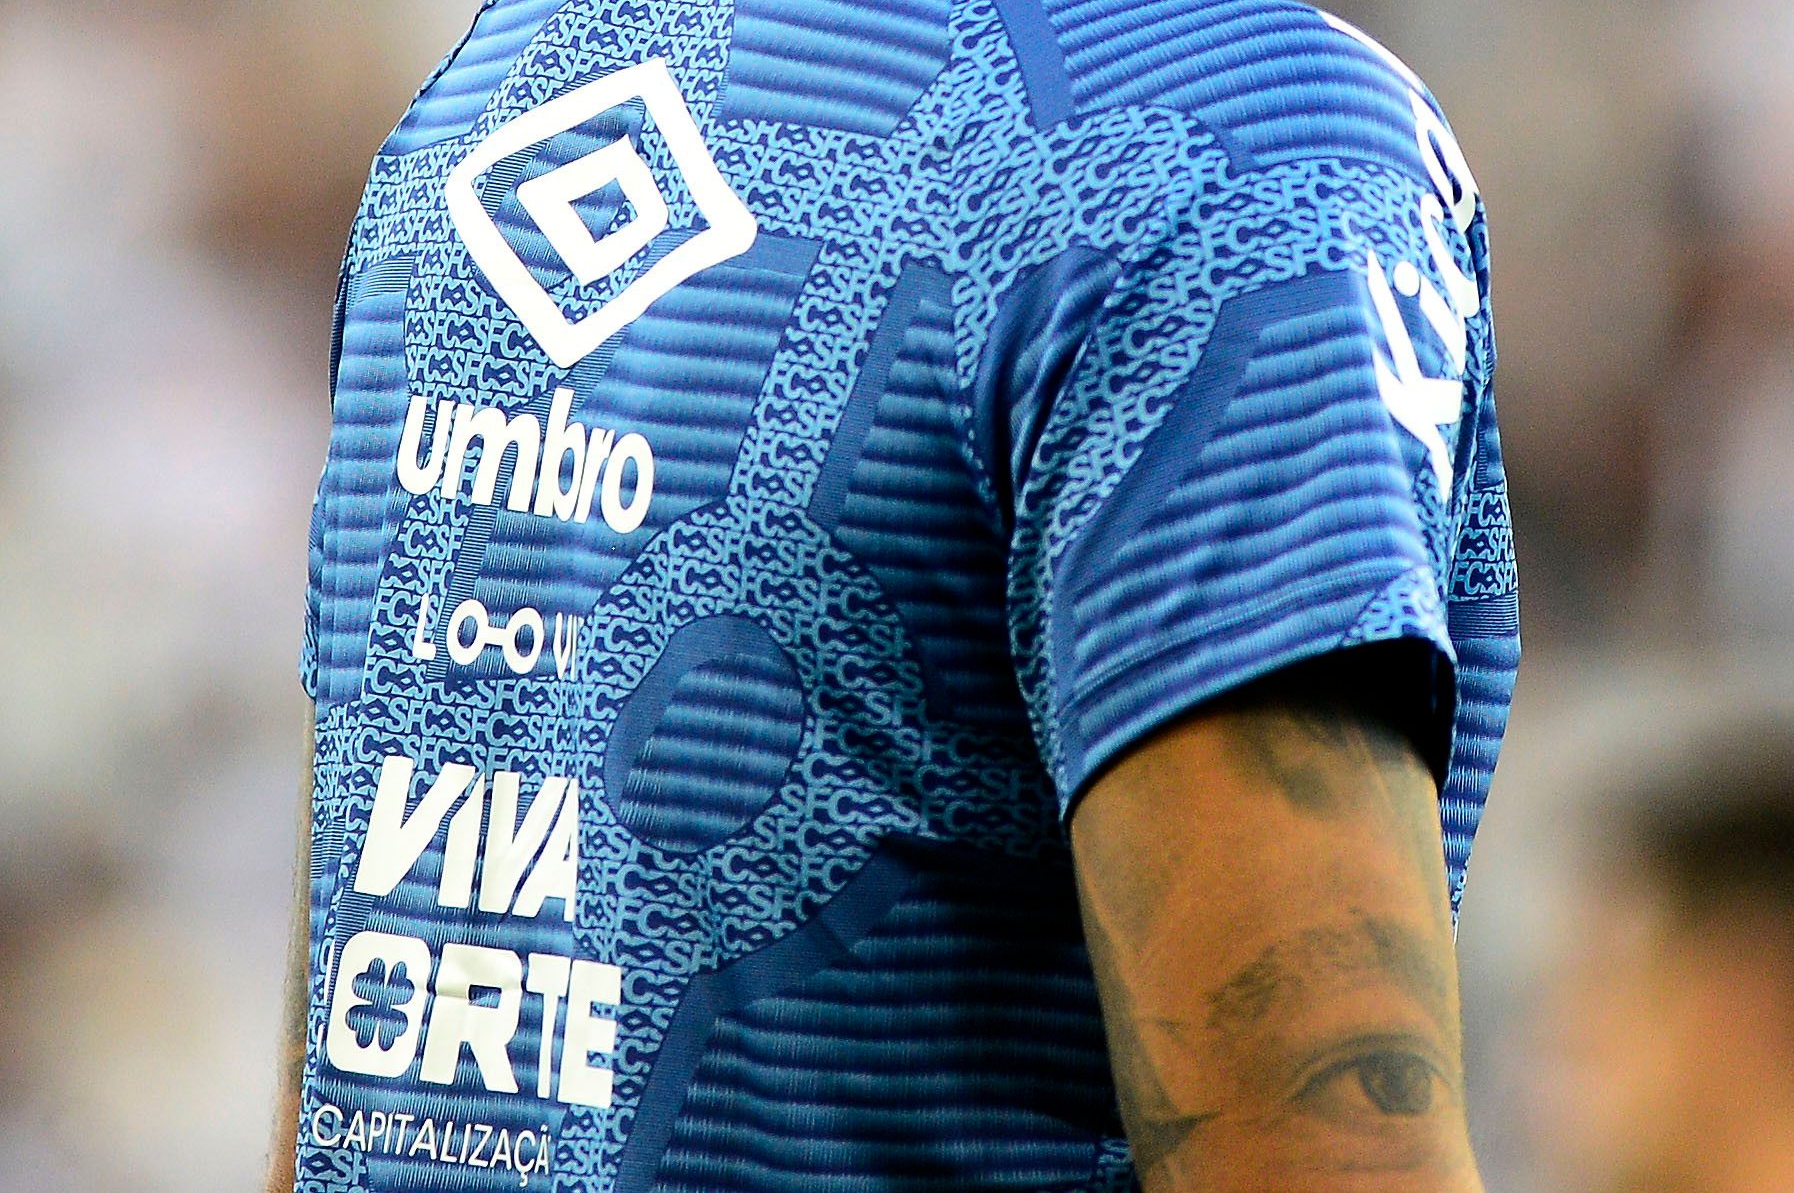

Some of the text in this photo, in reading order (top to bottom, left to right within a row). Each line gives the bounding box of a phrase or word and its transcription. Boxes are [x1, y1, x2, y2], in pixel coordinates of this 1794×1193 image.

[397, 388, 655, 534] umbro
[353, 755, 581, 922] VIVA
[316, 931, 623, 1109] ORTE
[311, 1104, 550, 1188] CAPITALIZAÇÃ
